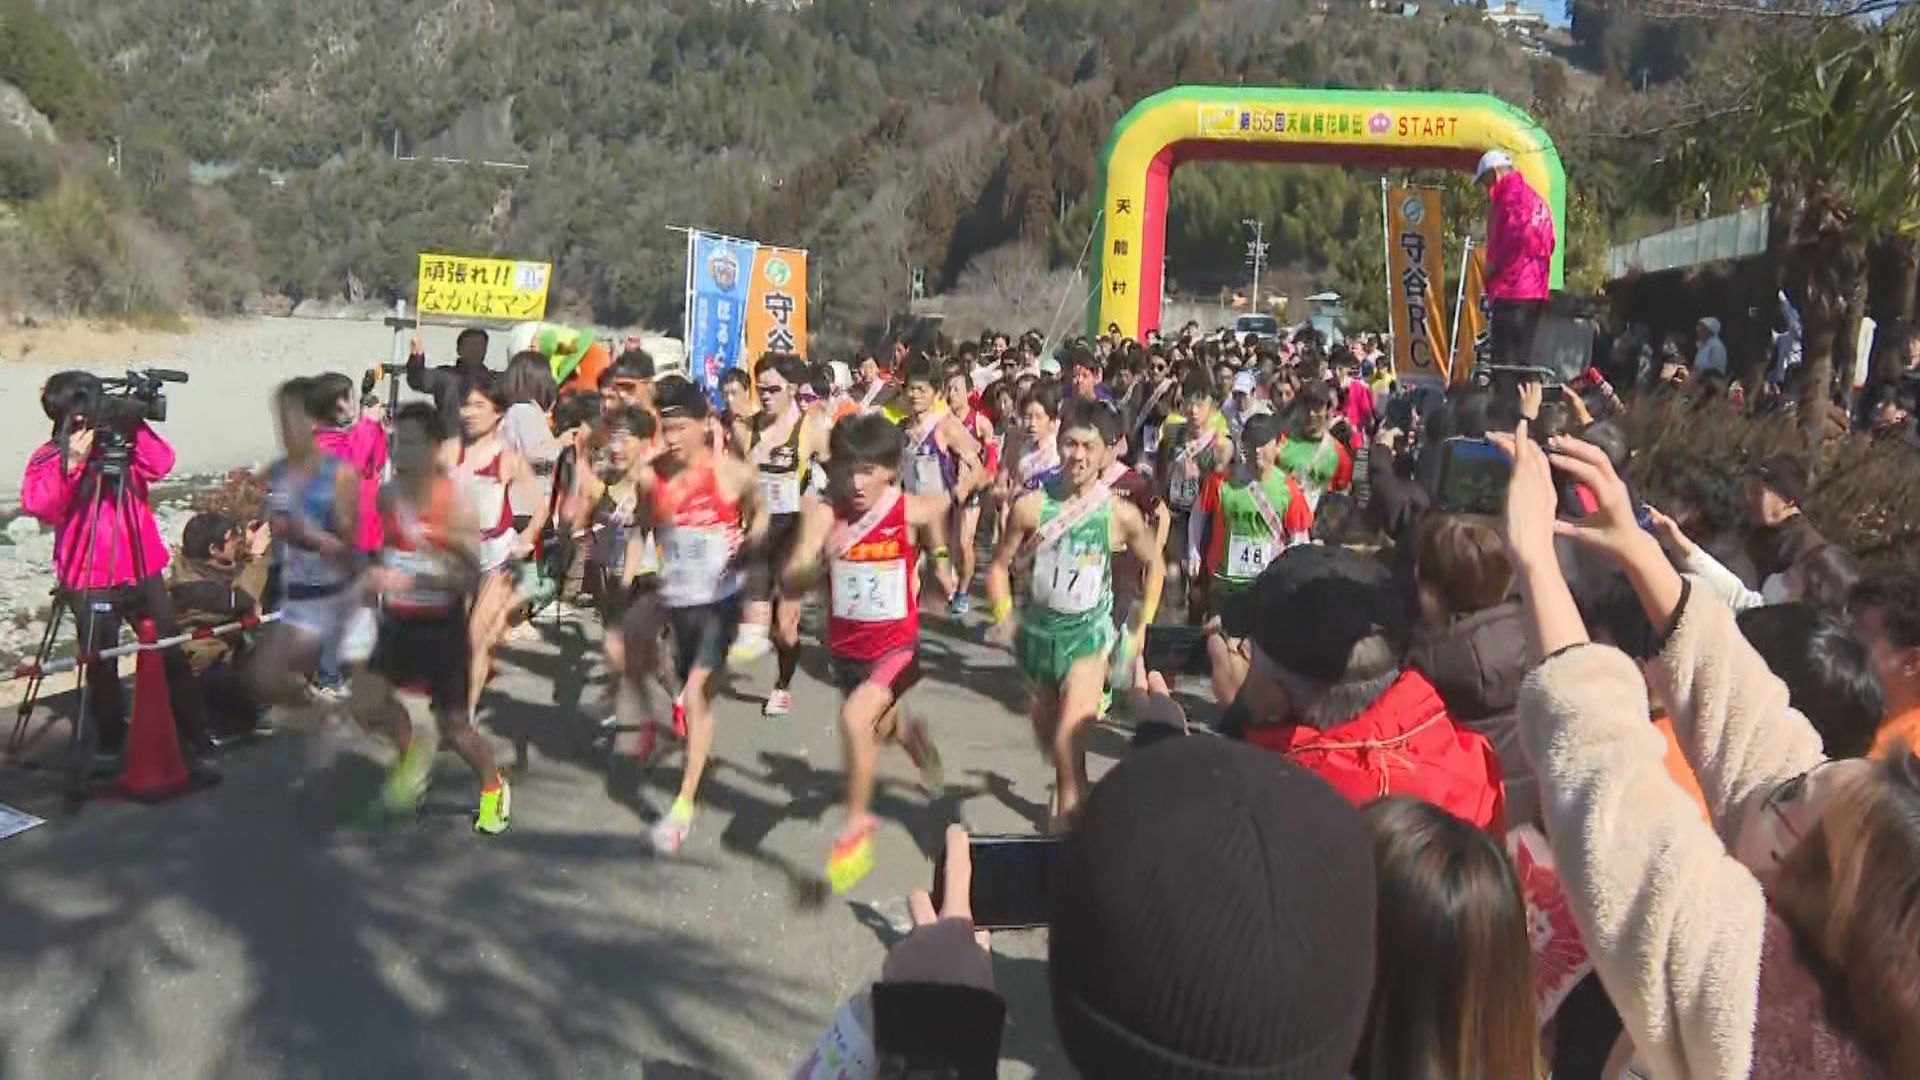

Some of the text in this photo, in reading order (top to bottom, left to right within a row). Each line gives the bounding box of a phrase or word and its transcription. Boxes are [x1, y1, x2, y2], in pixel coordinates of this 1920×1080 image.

[1398, 116, 1458, 137] START
[1401, 231, 1431, 369] 守谷RC
[1052, 566, 1080, 592] 17
